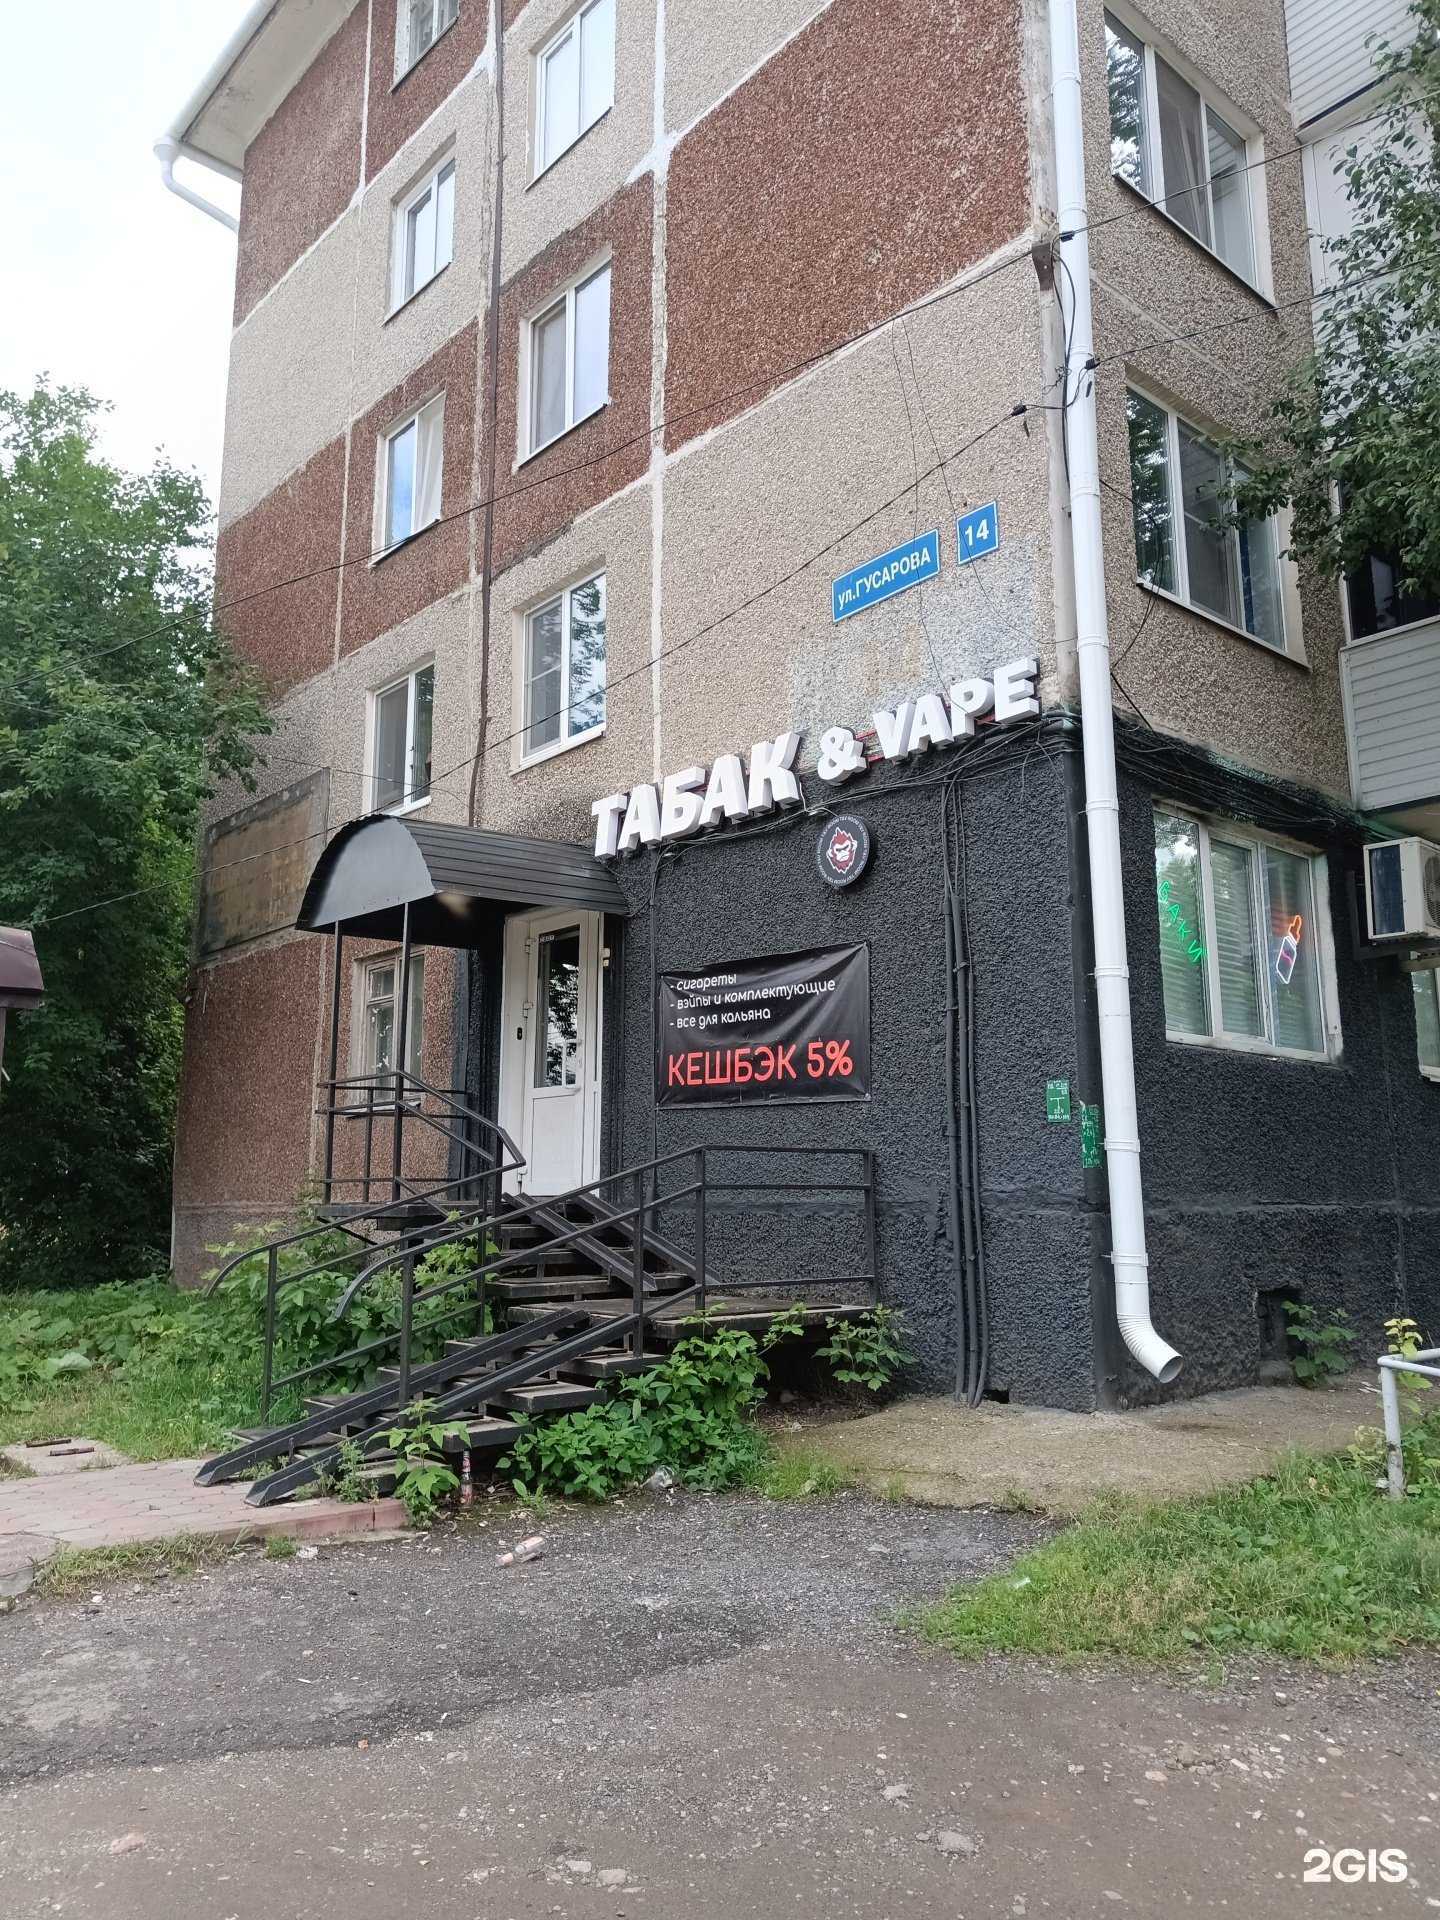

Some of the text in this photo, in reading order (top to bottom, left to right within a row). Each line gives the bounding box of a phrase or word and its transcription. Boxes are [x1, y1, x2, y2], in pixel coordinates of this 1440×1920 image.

[965, 519, 989, 547] 14
[838, 548, 931, 610] ул.ГУСАРОВА
[591, 731, 803, 860] ТАБАК
[817, 725, 868, 785] &
[873, 658, 1040, 761] VAPE
[677, 973, 737, 991] сигареты
[677, 994, 711, 1010] вэйпы
[714, 996, 721, 1005] и
[724, 979, 836, 1003] комплектующие
[676, 1017, 697, 1029] все
[699, 1015, 718, 1030] для
[721, 1007, 771, 1023] кальяна
[668, 1039, 854, 1087] КЕШБЭК 5%
